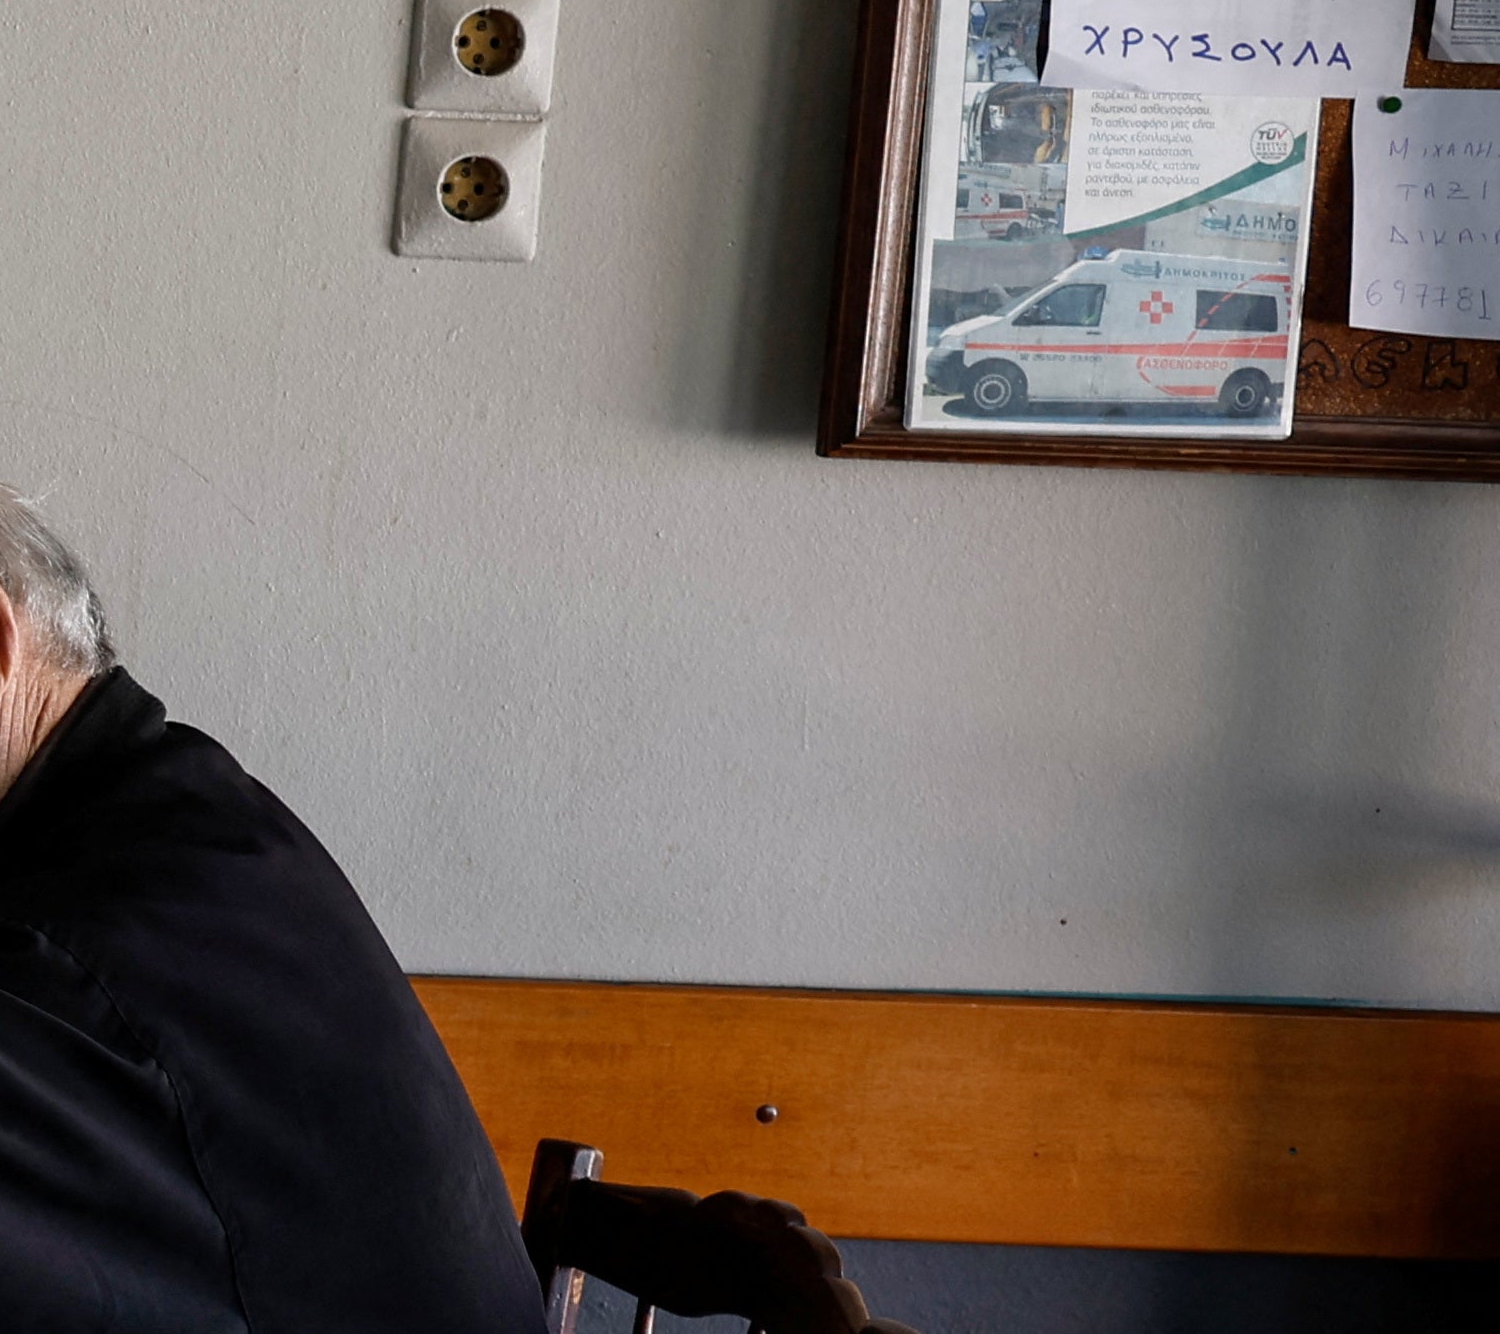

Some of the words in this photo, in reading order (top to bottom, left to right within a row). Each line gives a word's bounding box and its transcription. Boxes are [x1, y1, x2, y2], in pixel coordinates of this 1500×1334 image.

[1083, 25, 1352, 71] ΧΡΥΣΟΥΛΑ
[1092, 119, 1102, 128] Το
[1105, 119, 1168, 129] ασθενοφόρο
[1171, 121, 1190, 130] μας
[1389, 137, 1500, 160] ΜΙΧΑΛΗ
[1163, 268, 1246, 282] ΔΗΜΟΚΡΙΤΟΣ
[1143, 359, 1228, 371] ΑΣΘΕΝΟΦΟΡΟ
